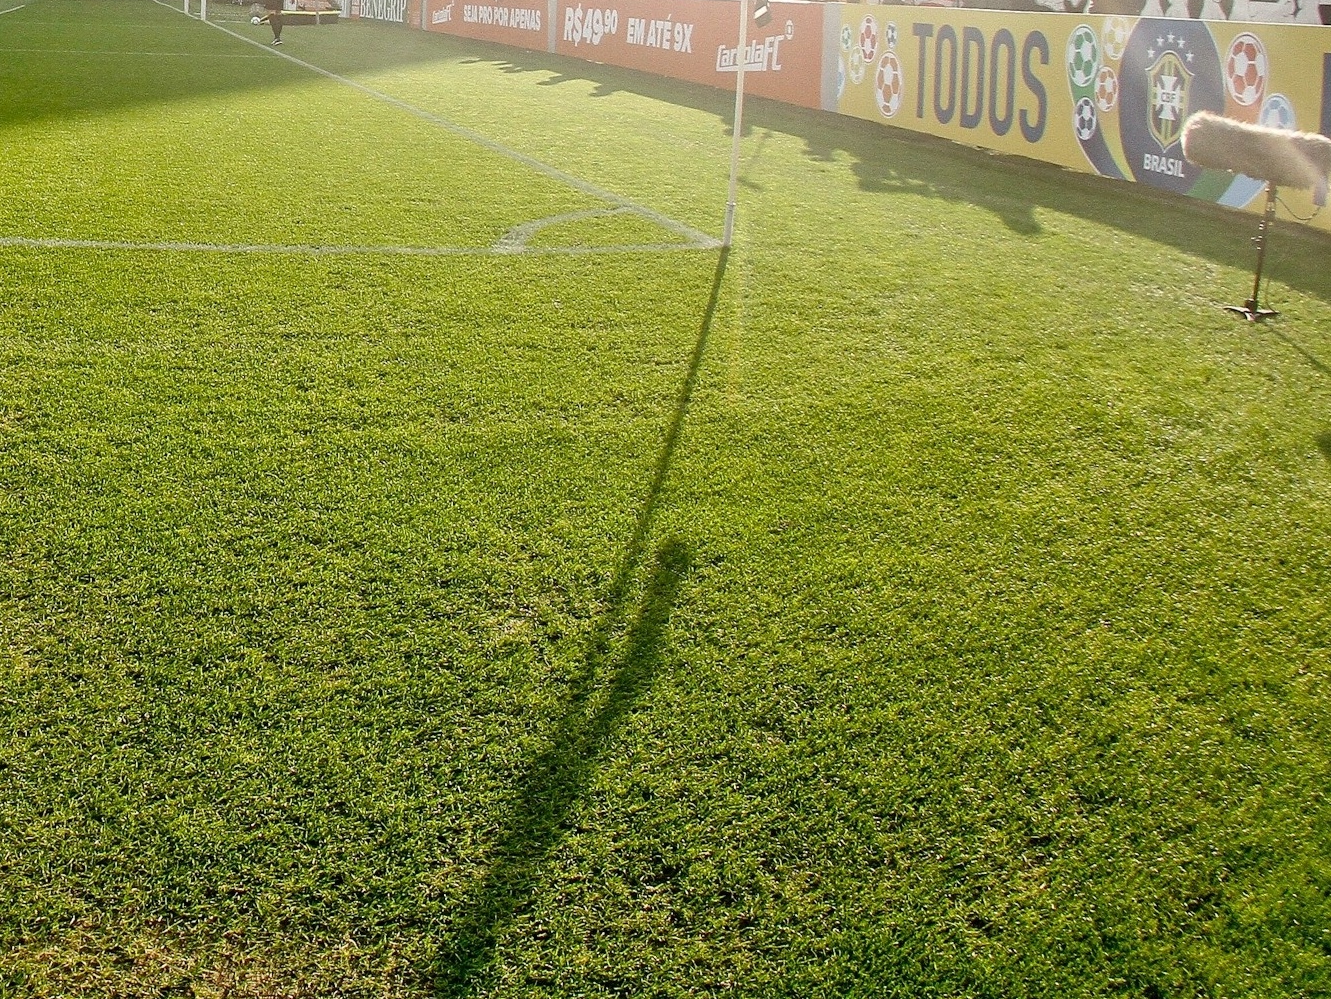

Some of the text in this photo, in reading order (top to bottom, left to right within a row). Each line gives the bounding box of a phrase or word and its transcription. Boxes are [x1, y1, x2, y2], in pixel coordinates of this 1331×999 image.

[463, 4, 541, 31] SEJA PRO POR APENAS
[626, 17, 645, 45] EM
[646, 14, 672, 50] ATÉ
[673, 22, 694, 53] 9X
[716, 35, 785, 71] CarolaFC
[912, 22, 1050, 144] TODOS
[1143, 153, 1185, 178] BRASIL
